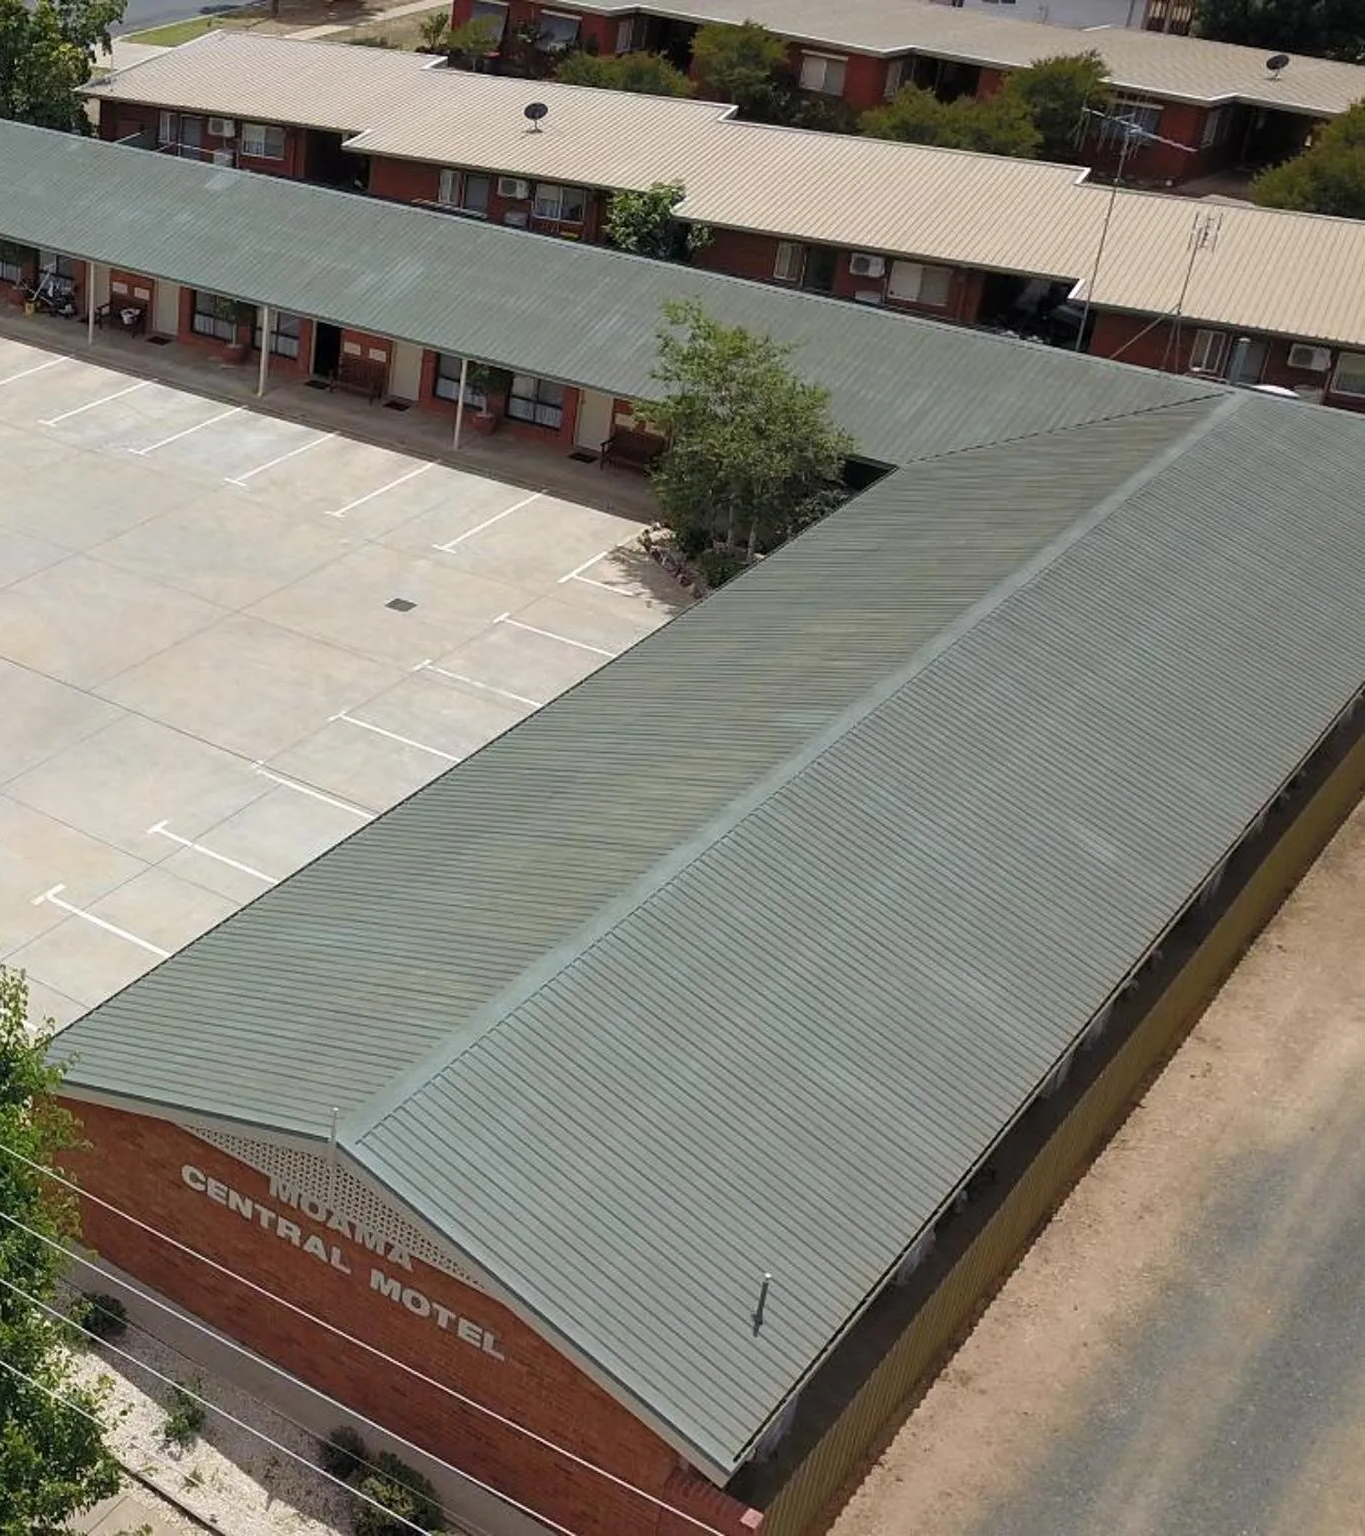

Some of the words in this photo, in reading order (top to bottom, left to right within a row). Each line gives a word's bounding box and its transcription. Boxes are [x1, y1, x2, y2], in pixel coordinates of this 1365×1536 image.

[180, 1164, 352, 1275] CENTRAL
[370, 1267, 506, 1361] MOTEL
[268, 1173, 414, 1273] MOAMA
